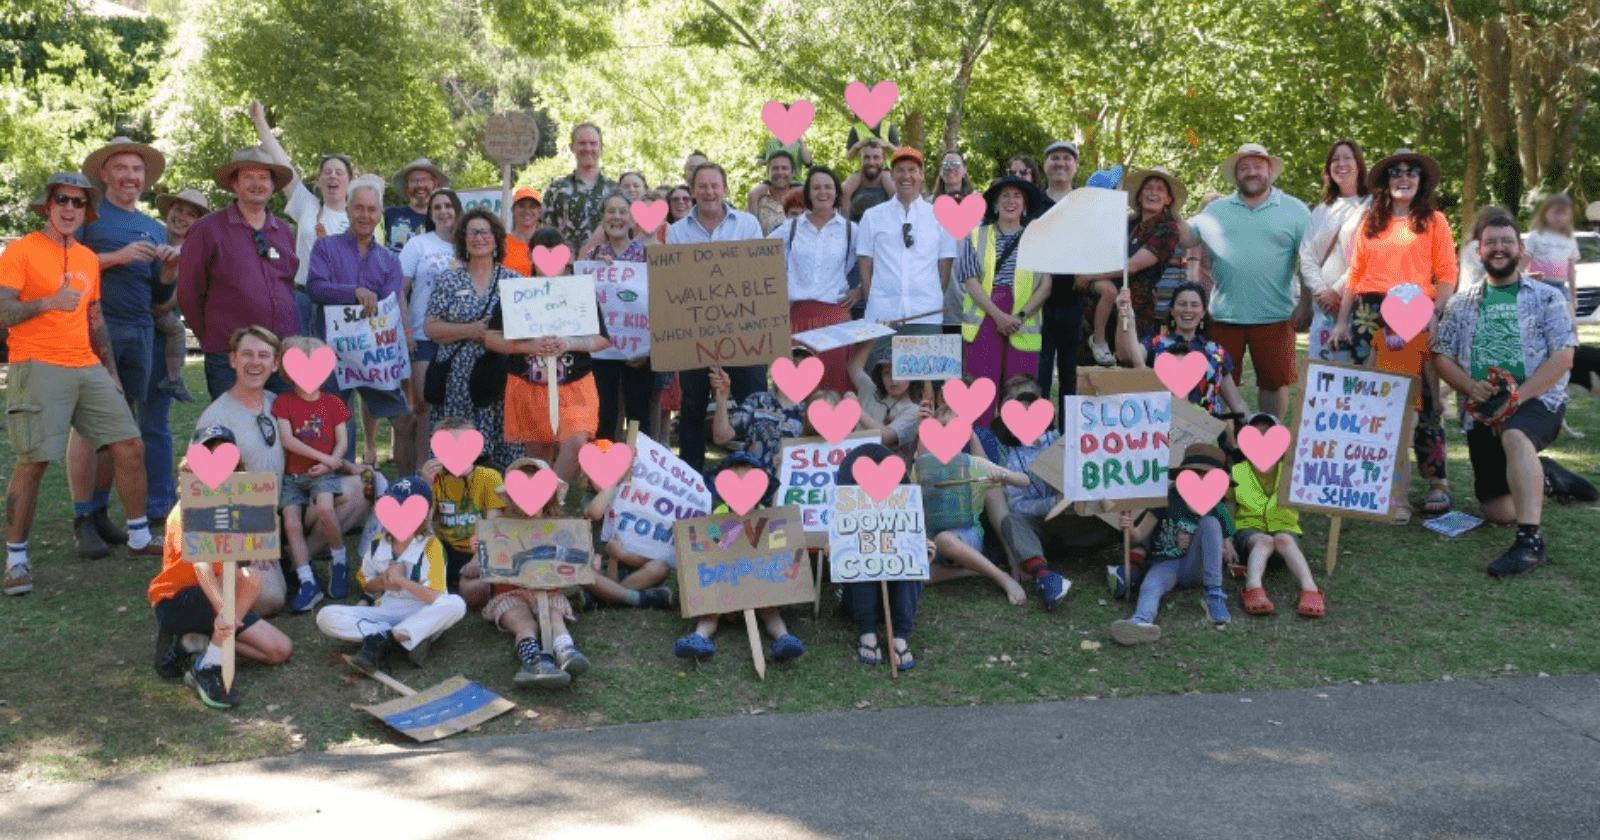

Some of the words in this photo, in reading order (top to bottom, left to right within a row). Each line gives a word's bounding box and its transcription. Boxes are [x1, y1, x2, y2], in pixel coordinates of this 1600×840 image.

[648, 251, 683, 267] WHAT
[694, 249, 714, 263] DO
[719, 246, 739, 259] WE
[747, 243, 782, 258] WANT
[710, 263, 724, 279] A
[664, 277, 778, 305] WALKABLE
[686, 300, 757, 323] TOWN
[651, 328, 693, 343] WHEN
[738, 318, 768, 331] WANT
[769, 315, 789, 328] IT
[334, 333, 371, 353] THE
[695, 332, 774, 363] NOW!
[362, 345, 396, 367] ARE
[1316, 370, 1335, 393] IT
[1342, 376, 1392, 398] WOULD
[1314, 411, 1361, 435] COOL
[1368, 415, 1387, 434] IF
[1080, 430, 1170, 456] DOWN
[1311, 439, 1338, 460] WE
[1343, 444, 1389, 462] COULD
[650, 448, 696, 487] SLOW
[789, 447, 853, 471] SLO
[1303, 461, 1357, 488] WALK
[1360, 461, 1381, 485] TO
[620, 484, 651, 506] IN
[1317, 487, 1379, 511] SCHOOL
[185, 531, 233, 557] SAFE
[688, 517, 788, 553] LOVE
[857, 530, 899, 554] BE
[838, 554, 924, 580] COOL
